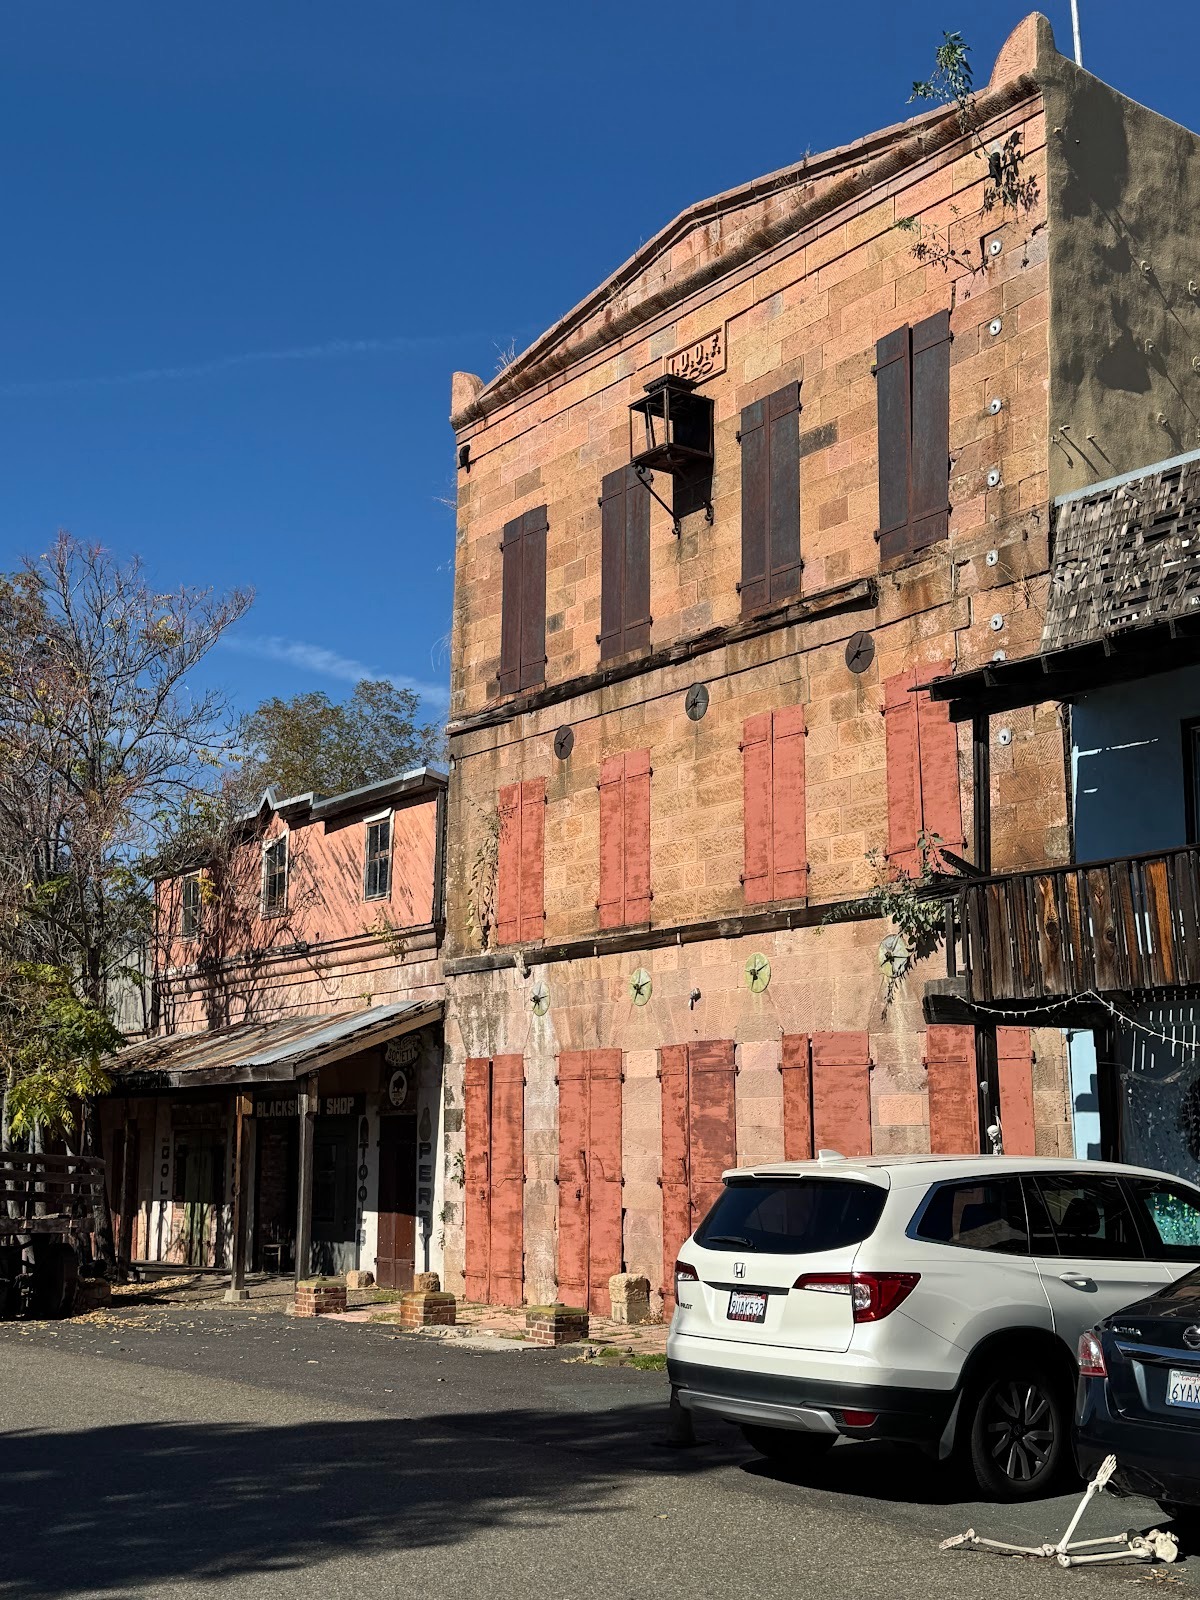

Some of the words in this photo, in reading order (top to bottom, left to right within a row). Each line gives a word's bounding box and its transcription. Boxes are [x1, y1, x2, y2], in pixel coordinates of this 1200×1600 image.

[257, 1099, 321, 1118] BLACKS
[326, 1097, 355, 1115] SHOP
[1112, 1325, 1142, 1337] ALTIMA
